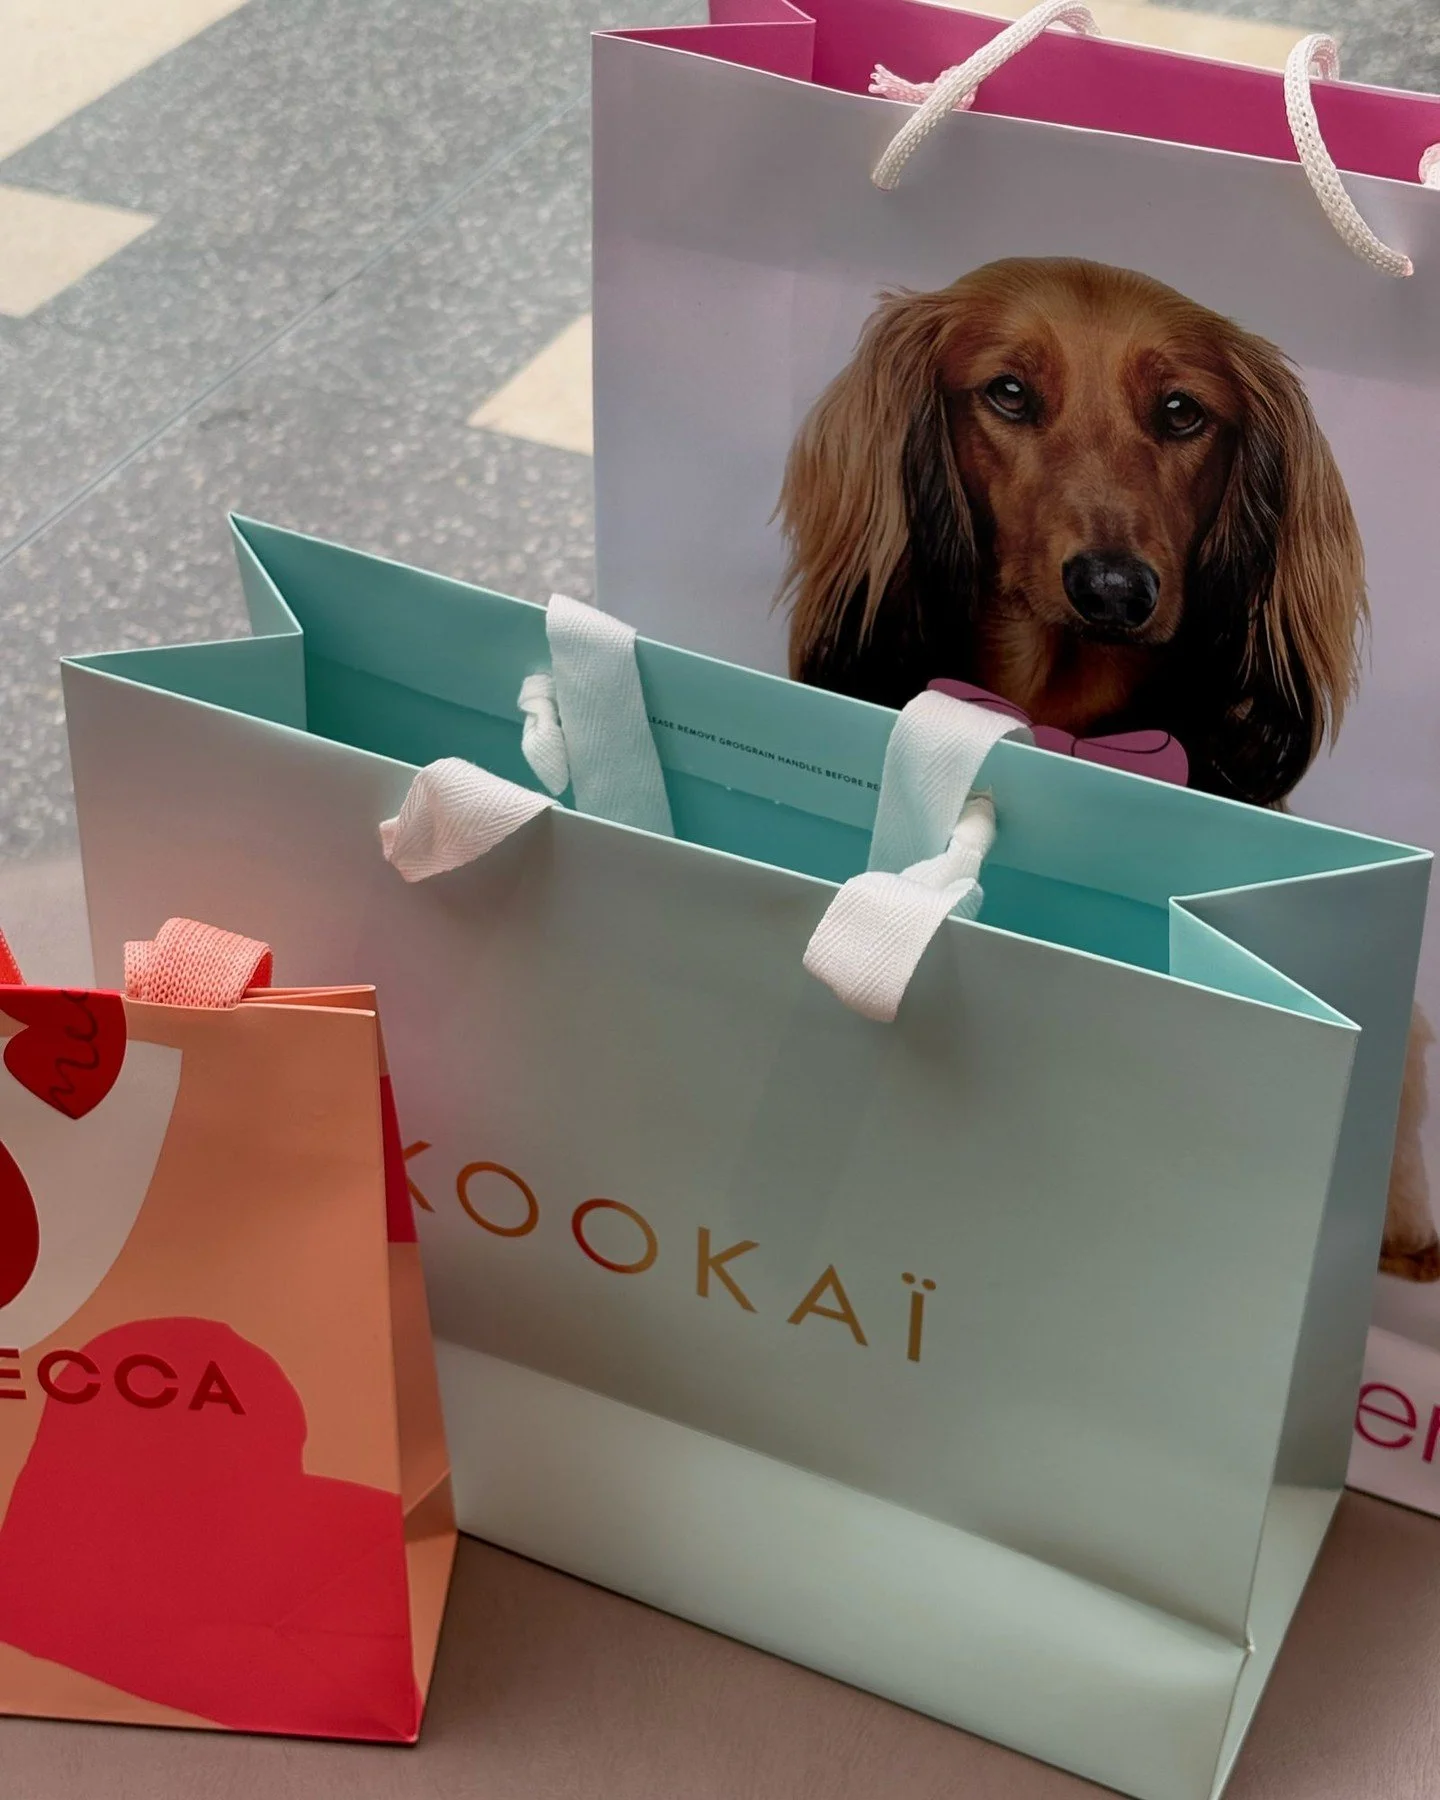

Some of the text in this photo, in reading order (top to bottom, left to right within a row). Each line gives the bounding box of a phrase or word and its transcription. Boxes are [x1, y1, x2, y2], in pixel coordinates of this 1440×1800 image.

[677, 724, 716, 742] REMOVE
[719, 738, 775, 760] GROSGRAIN
[778, 755, 822, 775] HANDLES
[825, 770, 863, 787] BEFORE
[866, 781, 881, 792] RE
